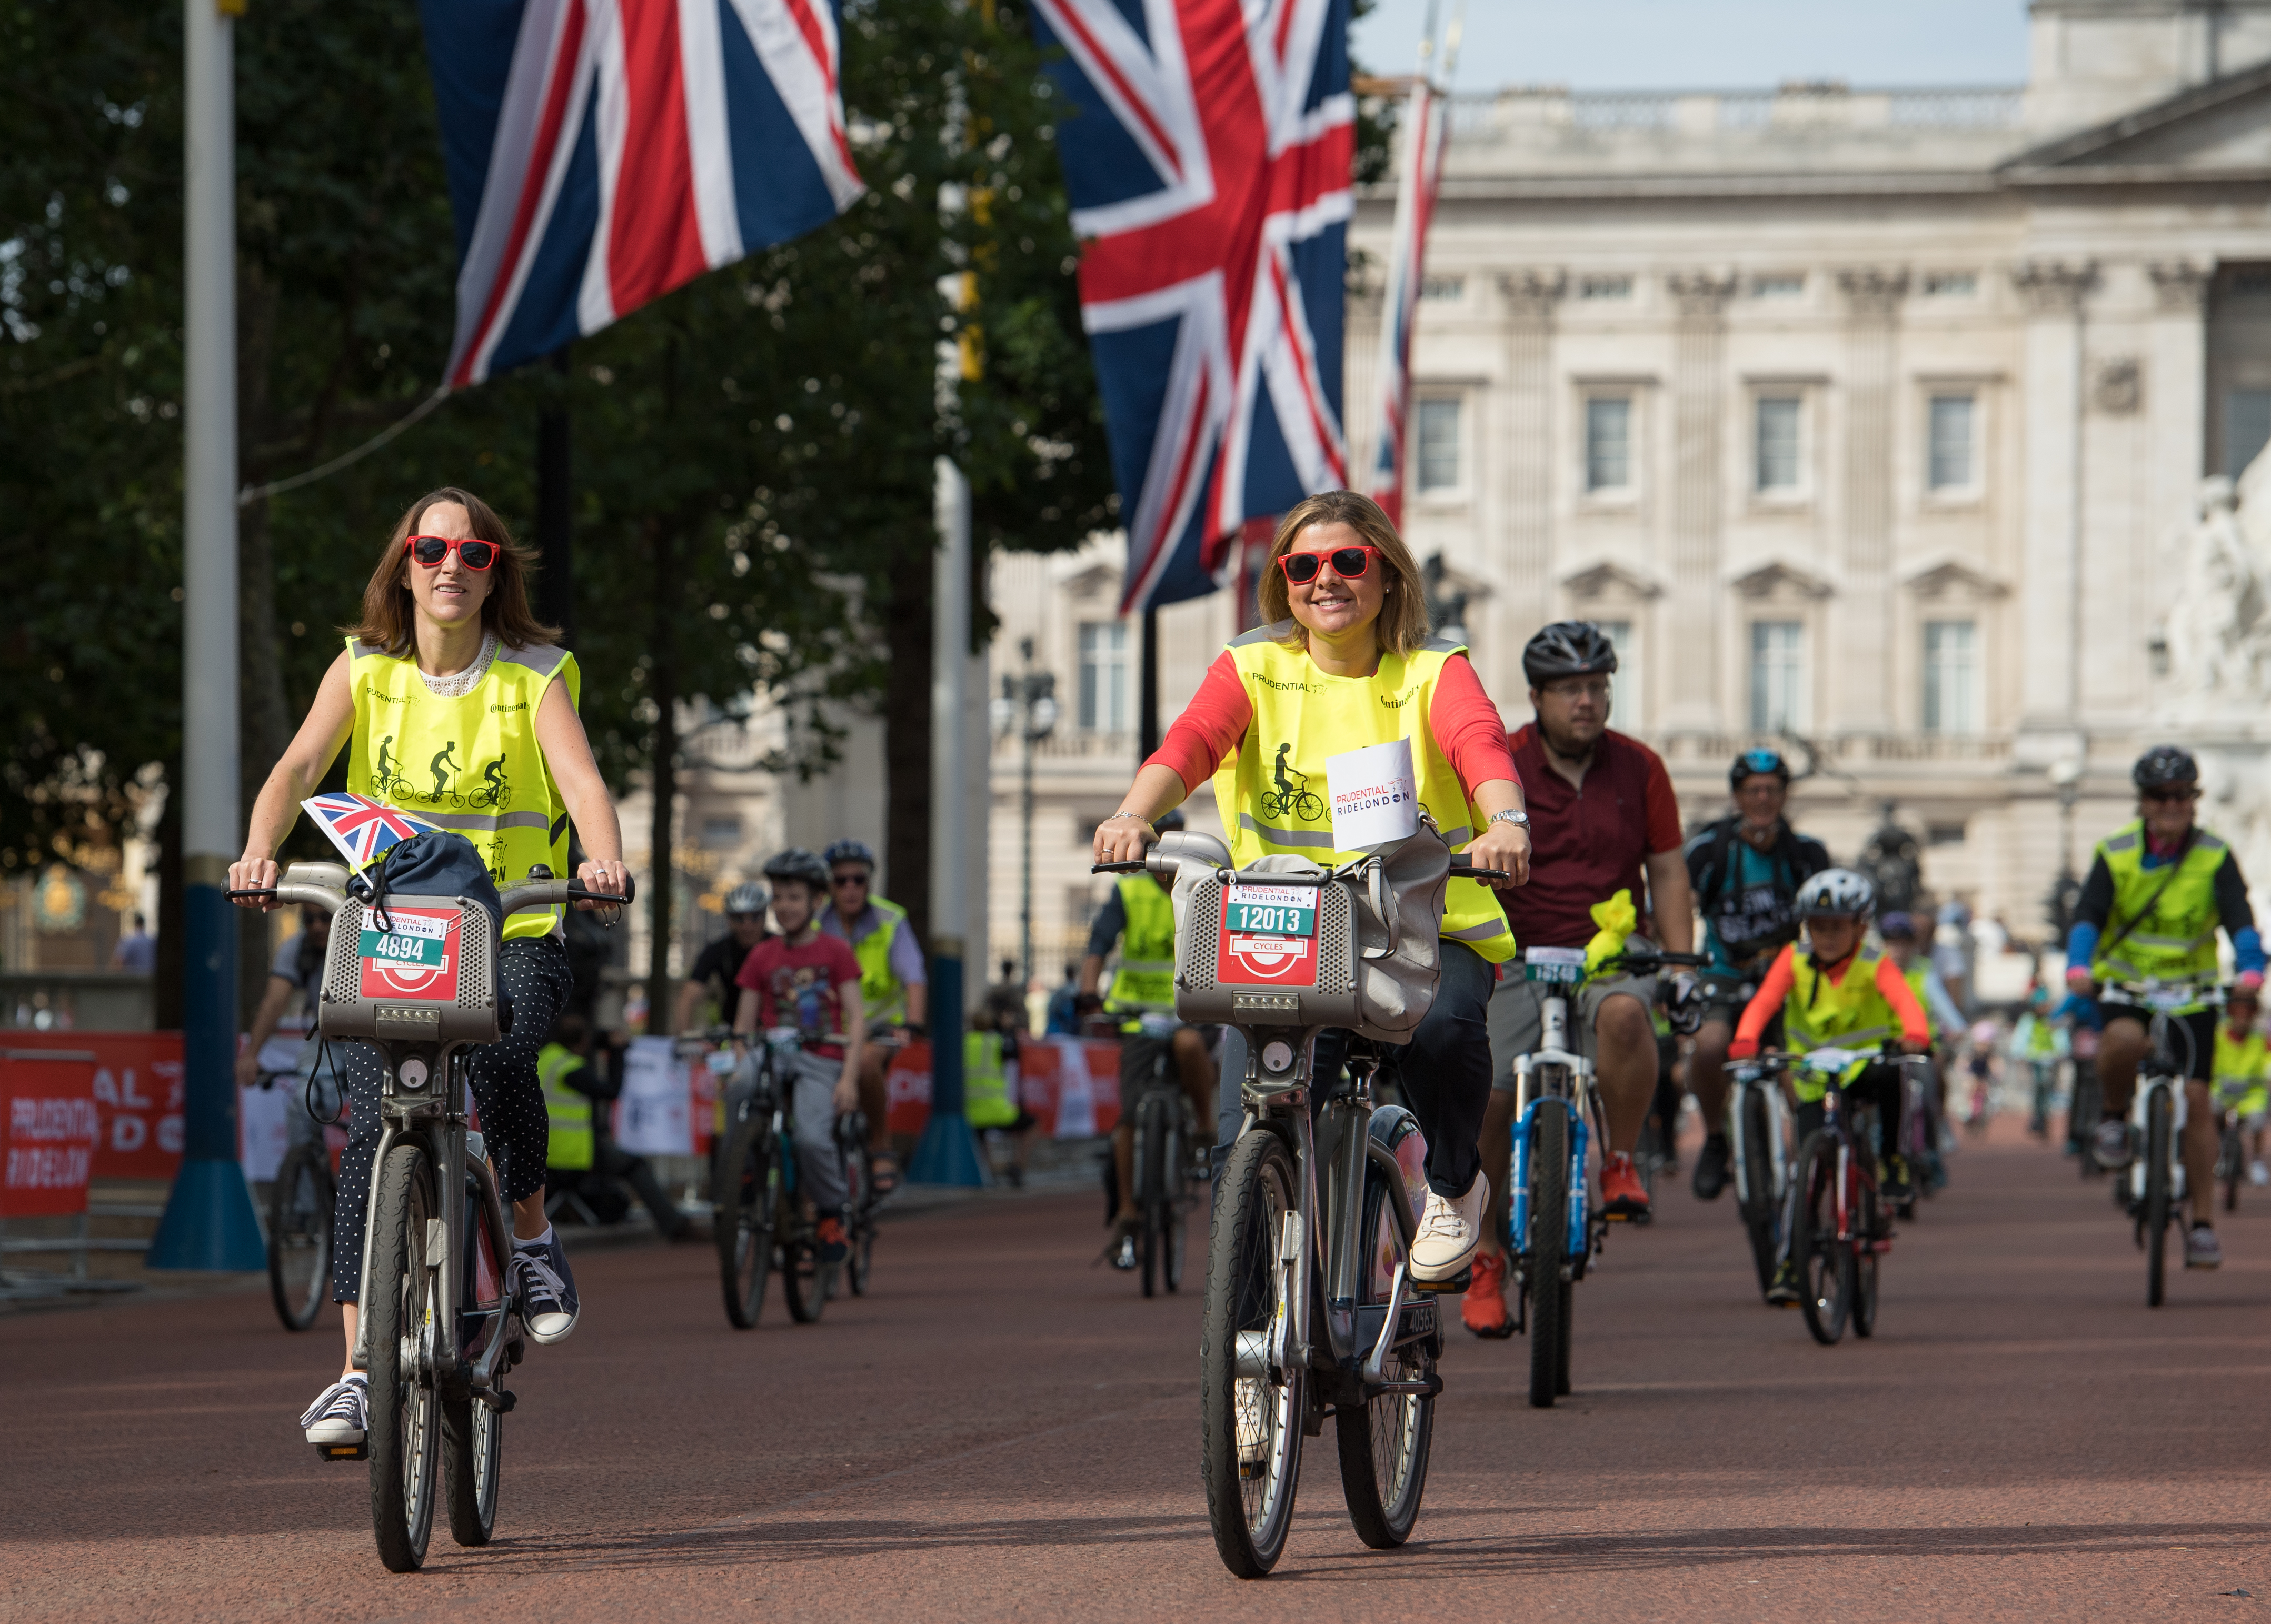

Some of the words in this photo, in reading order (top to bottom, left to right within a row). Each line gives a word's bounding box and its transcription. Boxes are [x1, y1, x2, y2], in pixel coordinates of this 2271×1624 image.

[1252, 672, 1310, 692] PRUDENTIAL
[1337, 785, 1389, 805] PRUDENTIAL
[1338, 791, 1410, 816] RIDELONDON
[1241, 893, 1302, 902] RIDELONDON
[1242, 885, 1290, 894] PRUDENTIAL
[376, 914, 421, 925] PRDENTIAL
[1240, 906, 1300, 932] 12013
[376, 935, 424, 960] 4894
[1253, 942, 1283, 951] CYCLES
[1409, 1307, 1434, 1333] 40563
